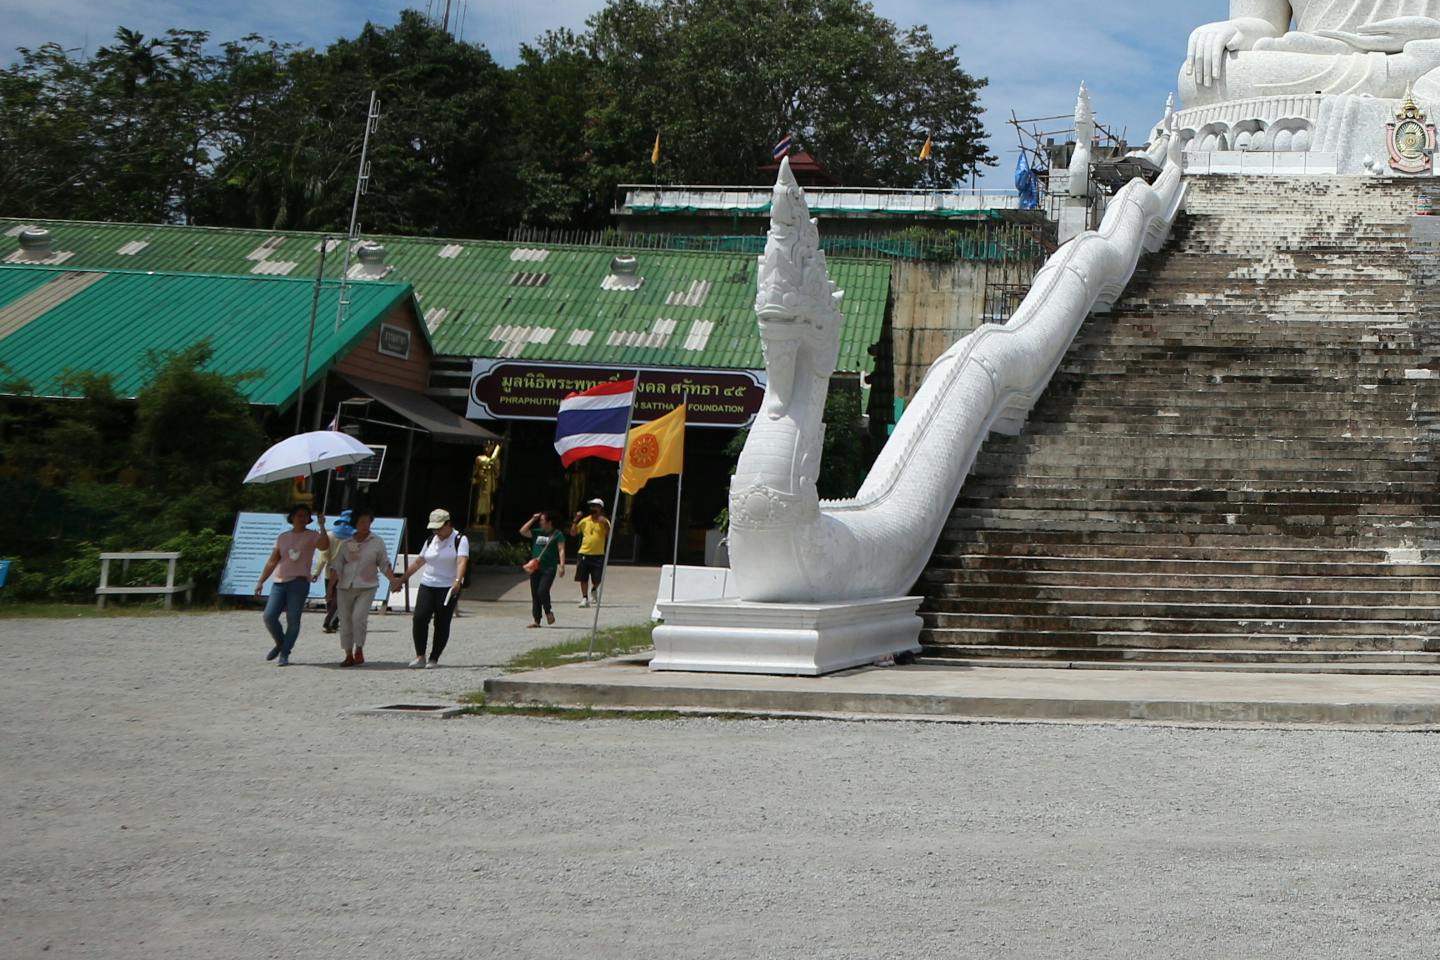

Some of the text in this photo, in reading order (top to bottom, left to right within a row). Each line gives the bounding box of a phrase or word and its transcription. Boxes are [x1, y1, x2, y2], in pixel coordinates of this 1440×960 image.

[670, 379, 719, 396] ศรัทธา
[723, 386, 747, 397] ๔๕
[640, 401, 674, 410] SATTHA
[687, 403, 744, 413] FOUNDATION
